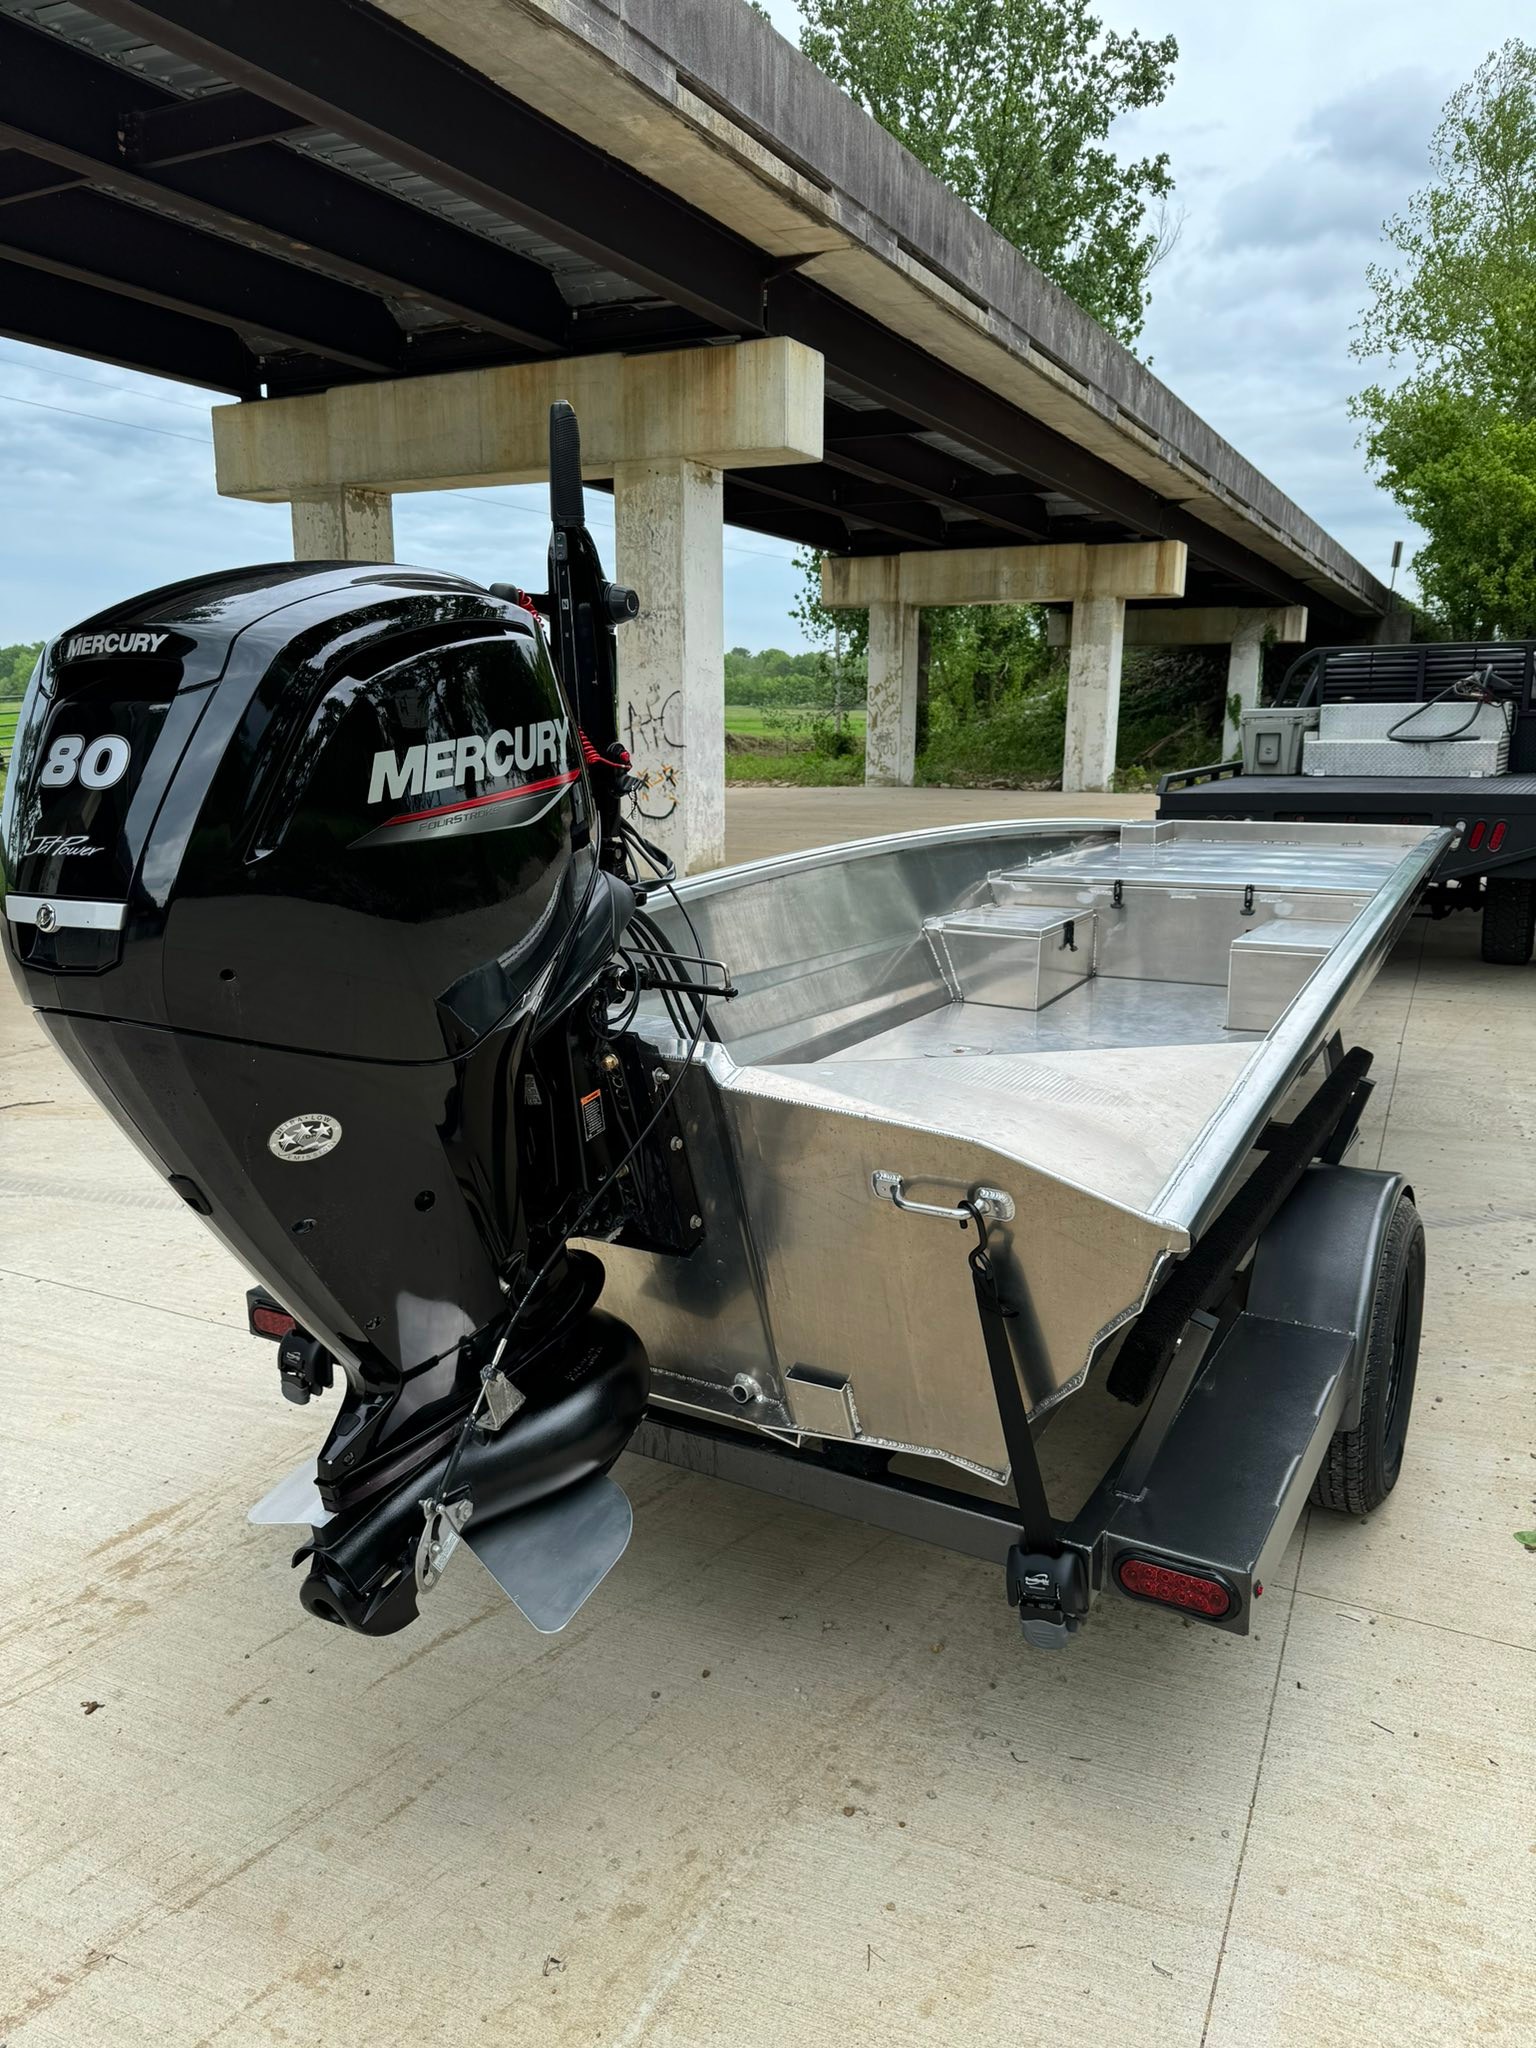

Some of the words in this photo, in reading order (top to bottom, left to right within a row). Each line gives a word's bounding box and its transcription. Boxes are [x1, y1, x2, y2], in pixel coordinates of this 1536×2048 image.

[66, 633, 169, 658] MERCURY
[41, 734, 131, 790] 80
[367, 716, 569, 804] MERCURY
[275, 1117, 303, 1136] ULTRA
[310, 1115, 332, 1123] LOW
